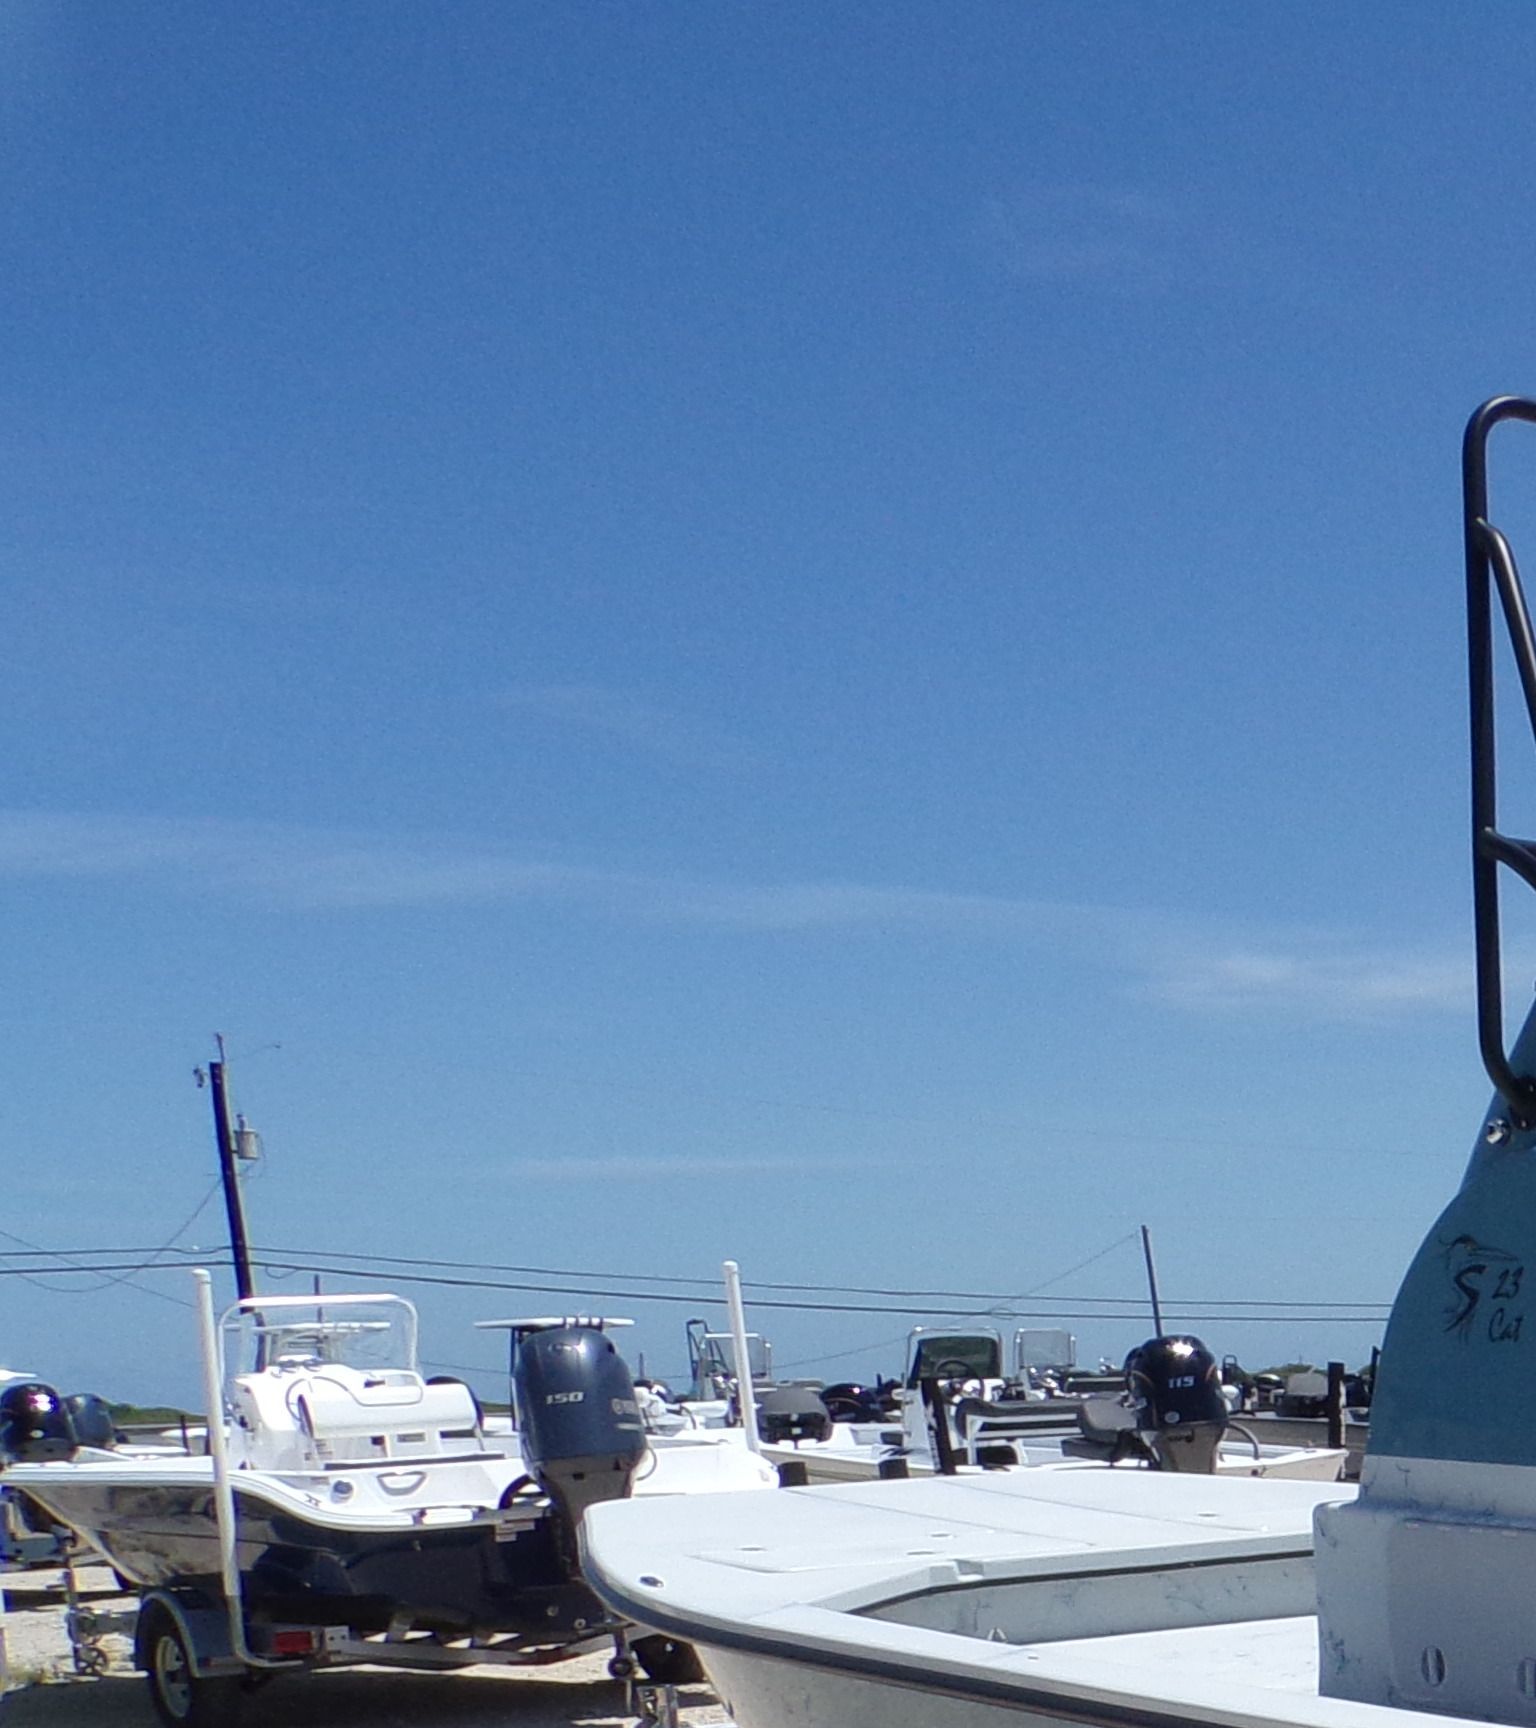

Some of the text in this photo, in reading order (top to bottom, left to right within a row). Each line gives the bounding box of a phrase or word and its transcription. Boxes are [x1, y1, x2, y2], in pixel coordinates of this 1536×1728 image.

[1491, 1265, 1524, 1300] 23
[1487, 1306, 1524, 1343] Cat
[1167, 1375, 1196, 1389] 115
[545, 1391, 585, 1405] 150
